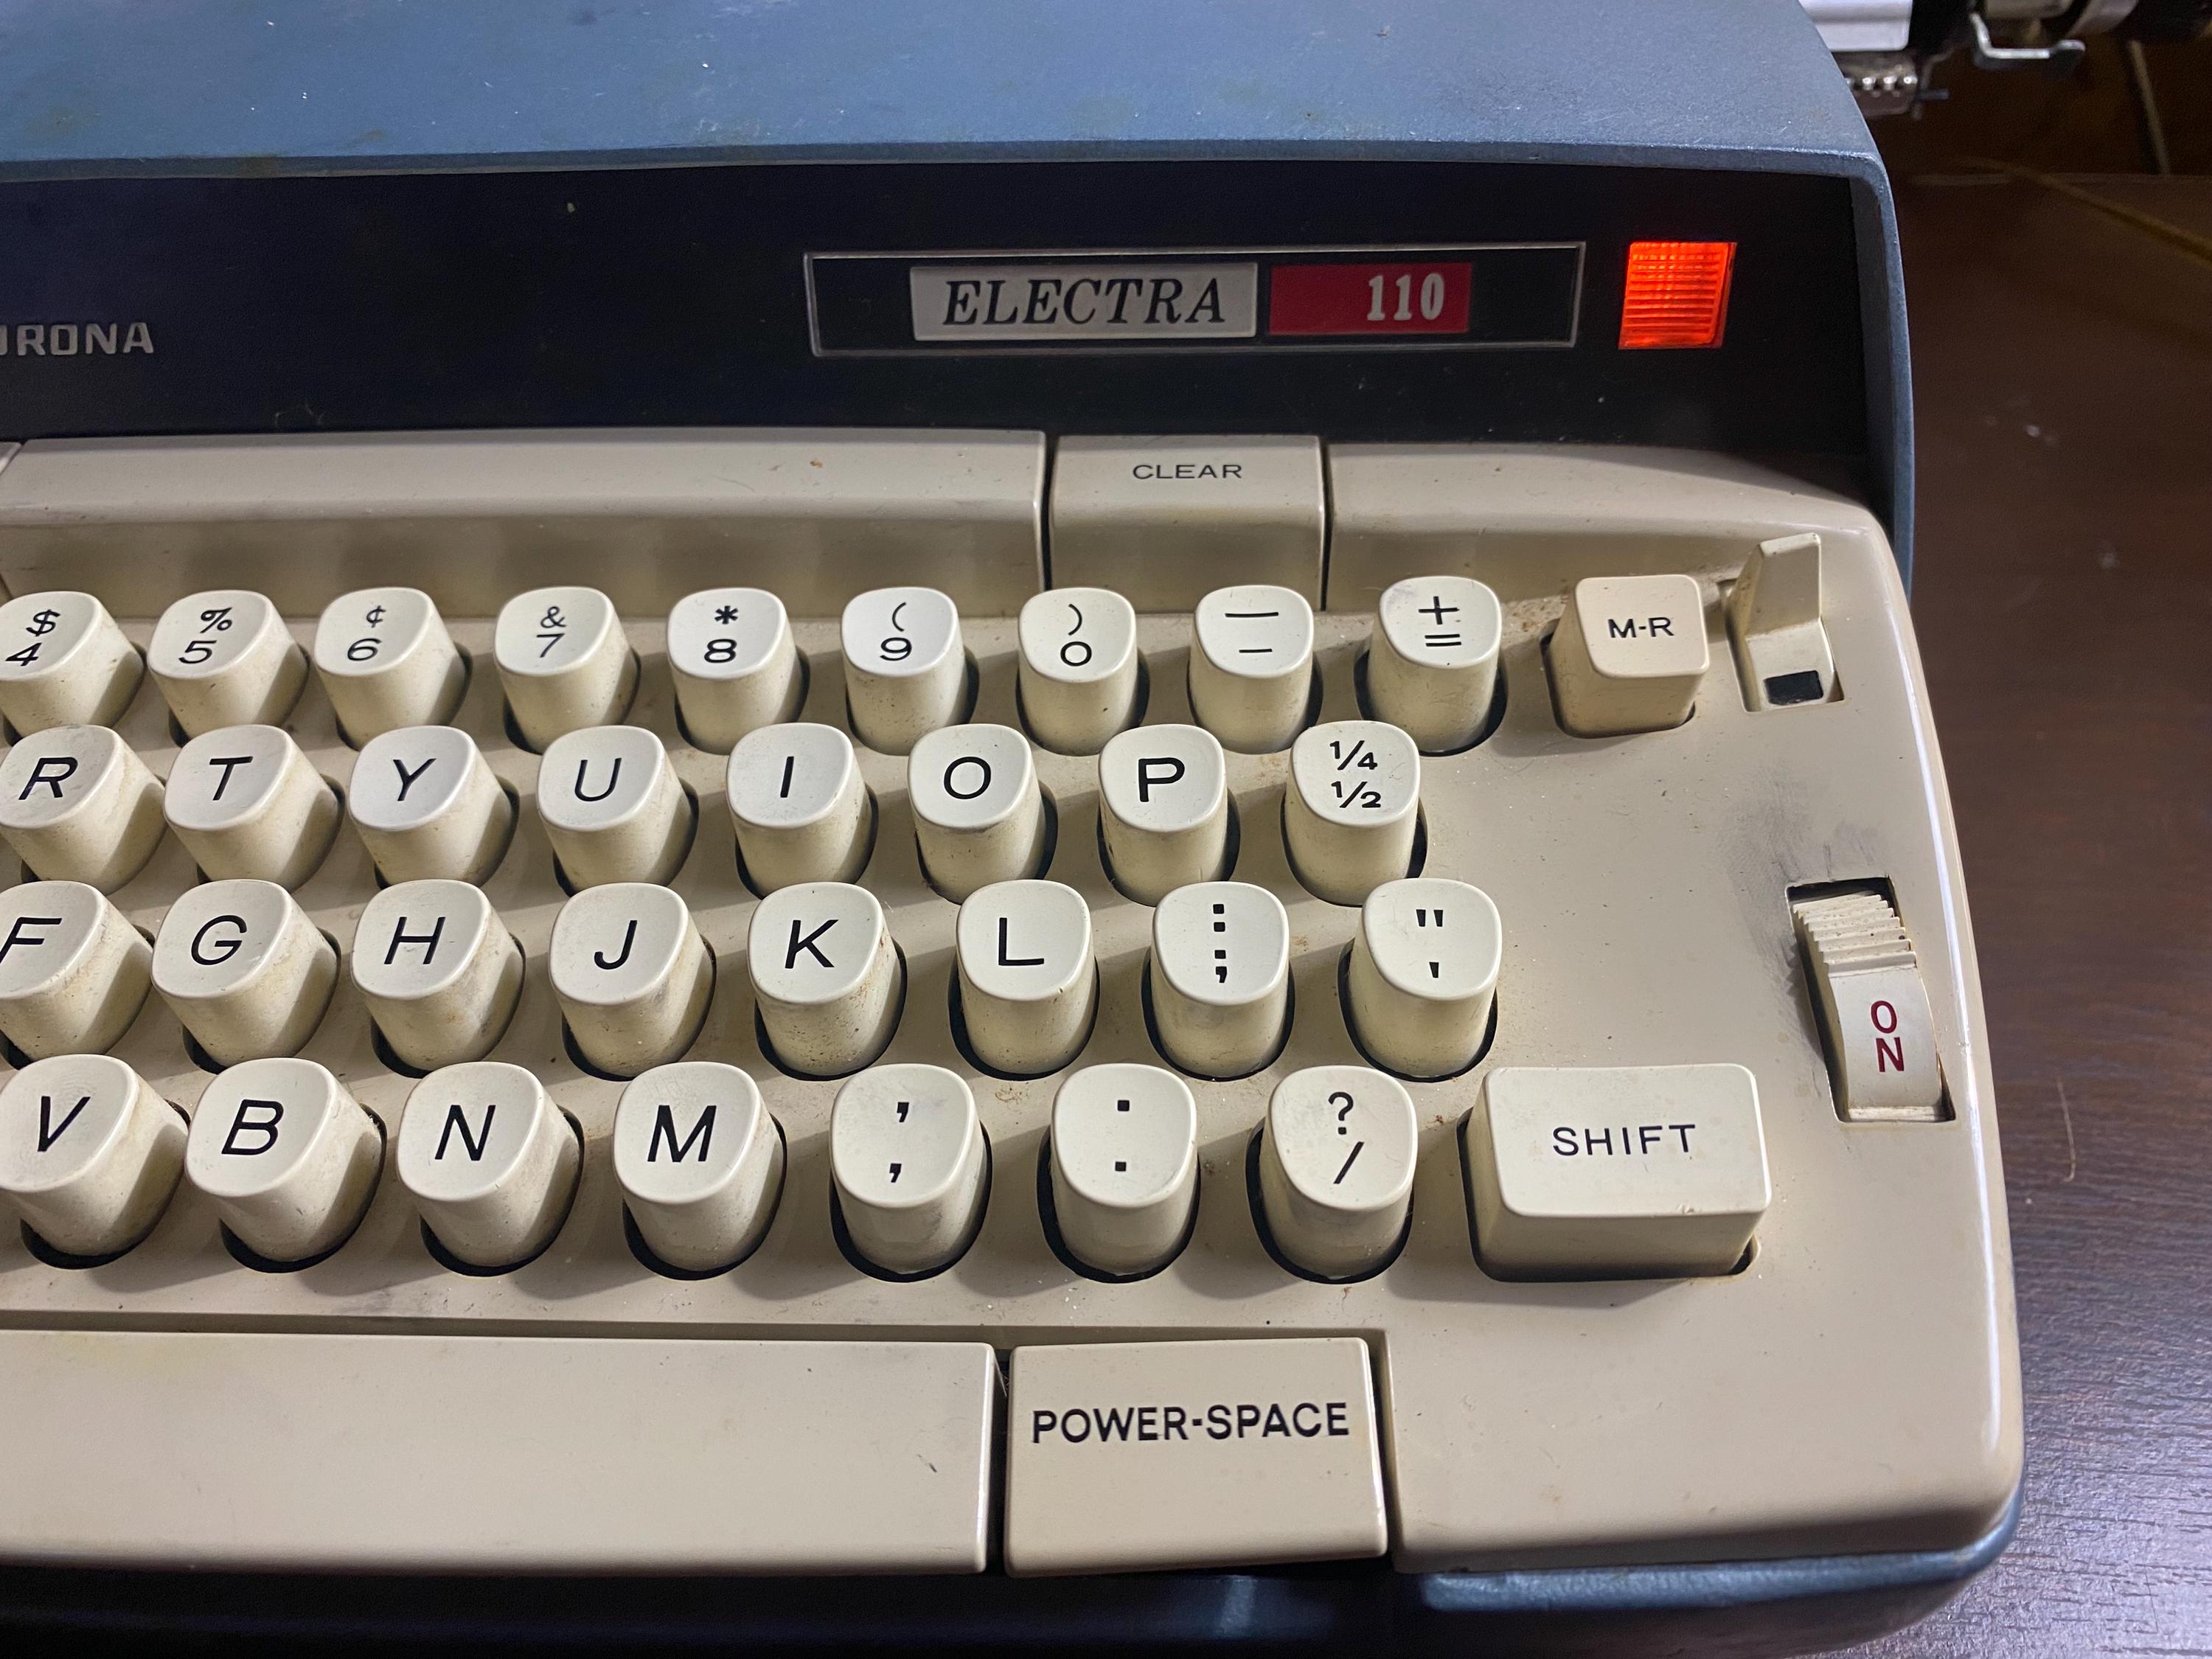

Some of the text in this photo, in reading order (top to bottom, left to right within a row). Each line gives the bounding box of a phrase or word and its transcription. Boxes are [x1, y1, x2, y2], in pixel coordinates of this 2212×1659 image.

[942, 273, 1445, 326] ELECTRA 110
[1133, 465, 1242, 479] CLEAR
[26, 609, 60, 637] $
[201, 608, 232, 633] %
[540, 605, 566, 628] &
[892, 602, 906, 632] (
[1068, 603, 1082, 636] )
[1419, 597, 1459, 625] +
[1608, 617, 1674, 638] M-R
[6, 642, 41, 667] 4
[178, 640, 217, 664] 5
[347, 639, 381, 661] 6
[536, 633, 566, 658] 7
[704, 639, 737, 663] 8
[880, 637, 912, 661] 9
[1425, 634, 1461, 647] =
[18, 757, 77, 800] R
[209, 756, 254, 801] T
[393, 759, 437, 801] Y
[574, 758, 622, 801] U
[780, 757, 794, 798] I
[944, 757, 991, 799] O
[1138, 757, 1185, 802] P
[0, 917, 62, 963] F
[190, 915, 247, 965] G
[384, 917, 445, 964] H
[594, 920, 637, 970] J
[785, 919, 838, 969] K
[998, 917, 1044, 966] L
[1871, 1001, 1905, 1073] ON
[38, 1096, 91, 1152] V
[221, 1099, 284, 1155] B
[435, 1105, 495, 1161] N
[647, 1105, 717, 1162] M
[1329, 1092, 1353, 1135] ?
[1554, 1124, 1695, 1155] SHIFT
[1033, 1402, 1349, 1443] POWER-SPACE
